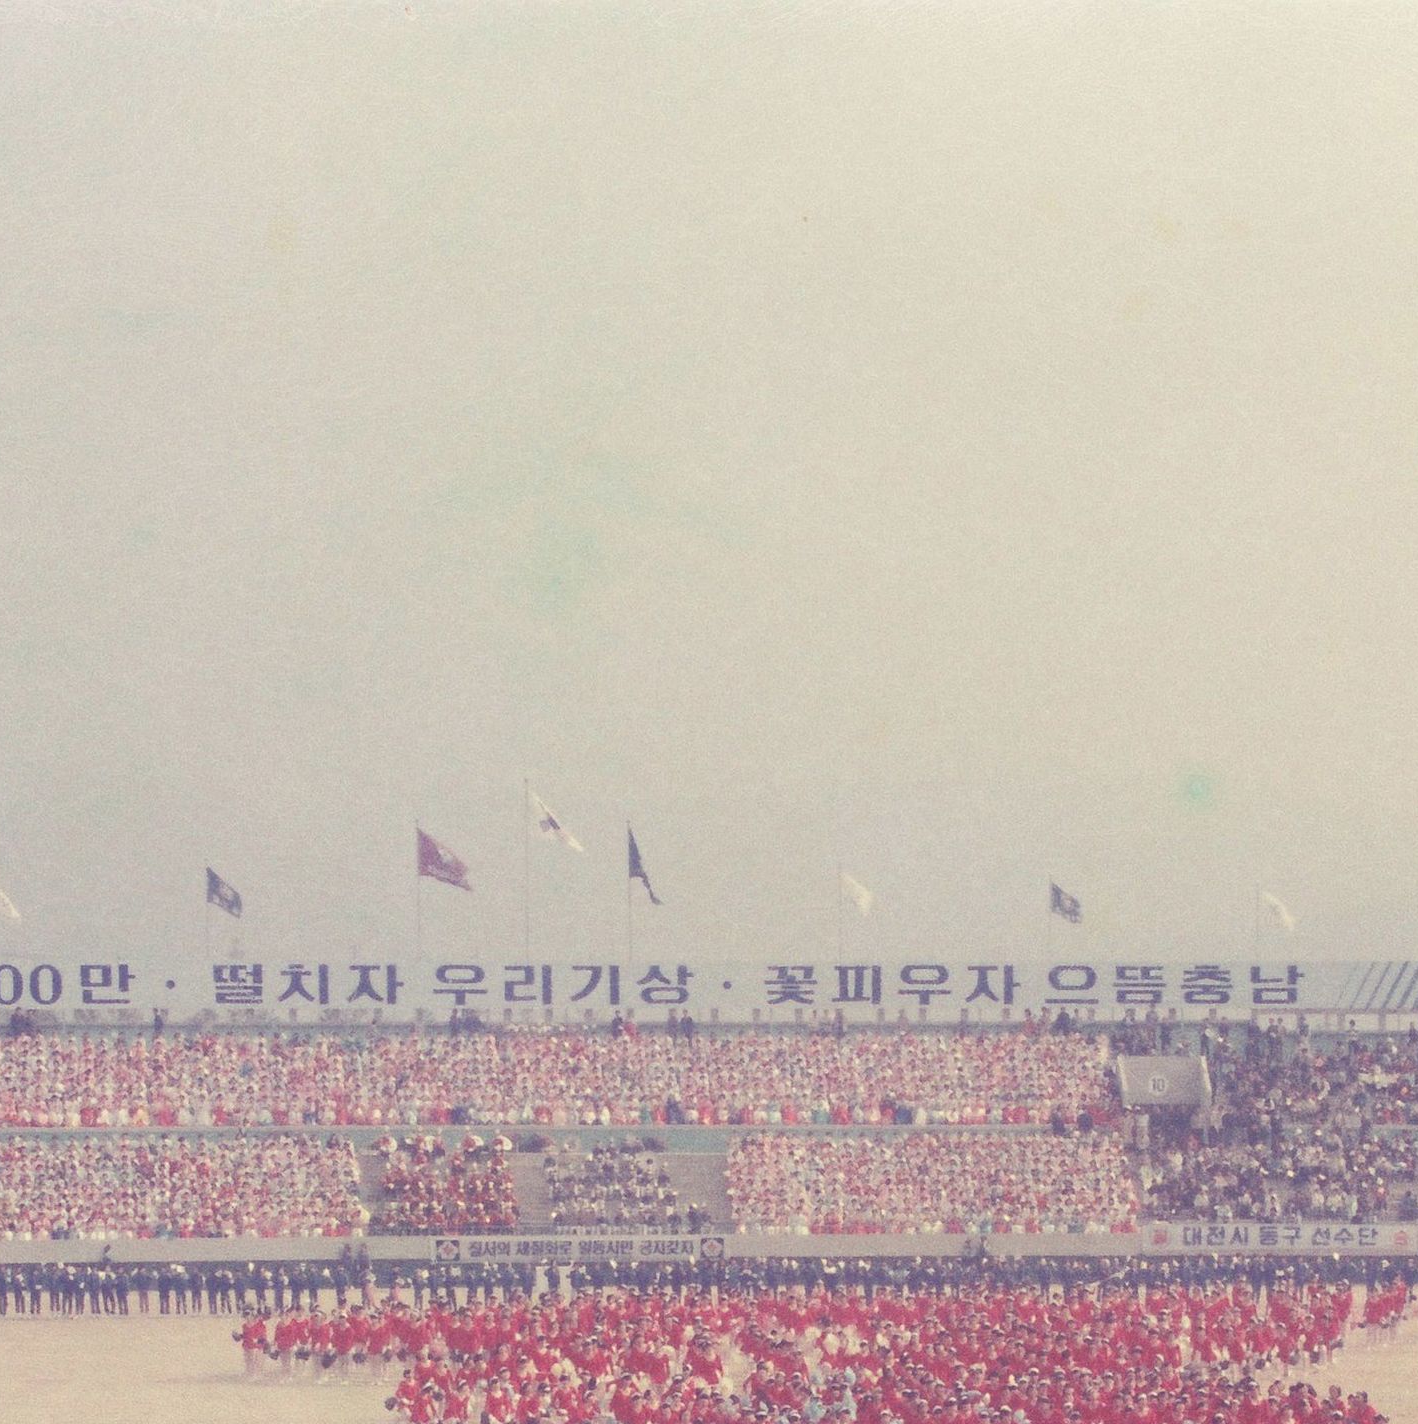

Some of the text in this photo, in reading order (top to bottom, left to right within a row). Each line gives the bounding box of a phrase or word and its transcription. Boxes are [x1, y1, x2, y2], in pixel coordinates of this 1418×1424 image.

[212, 964, 404, 1005] 떨치자
[432, 964, 691, 1005] 우리기상
[764, 964, 1022, 1005] 꽃피우자
[1047, 964, 1306, 1005] 으뜸충남
[1151, 1077, 1165, 1092] 10
[1183, 1225, 1379, 1246] 대전시 동구 선수단
